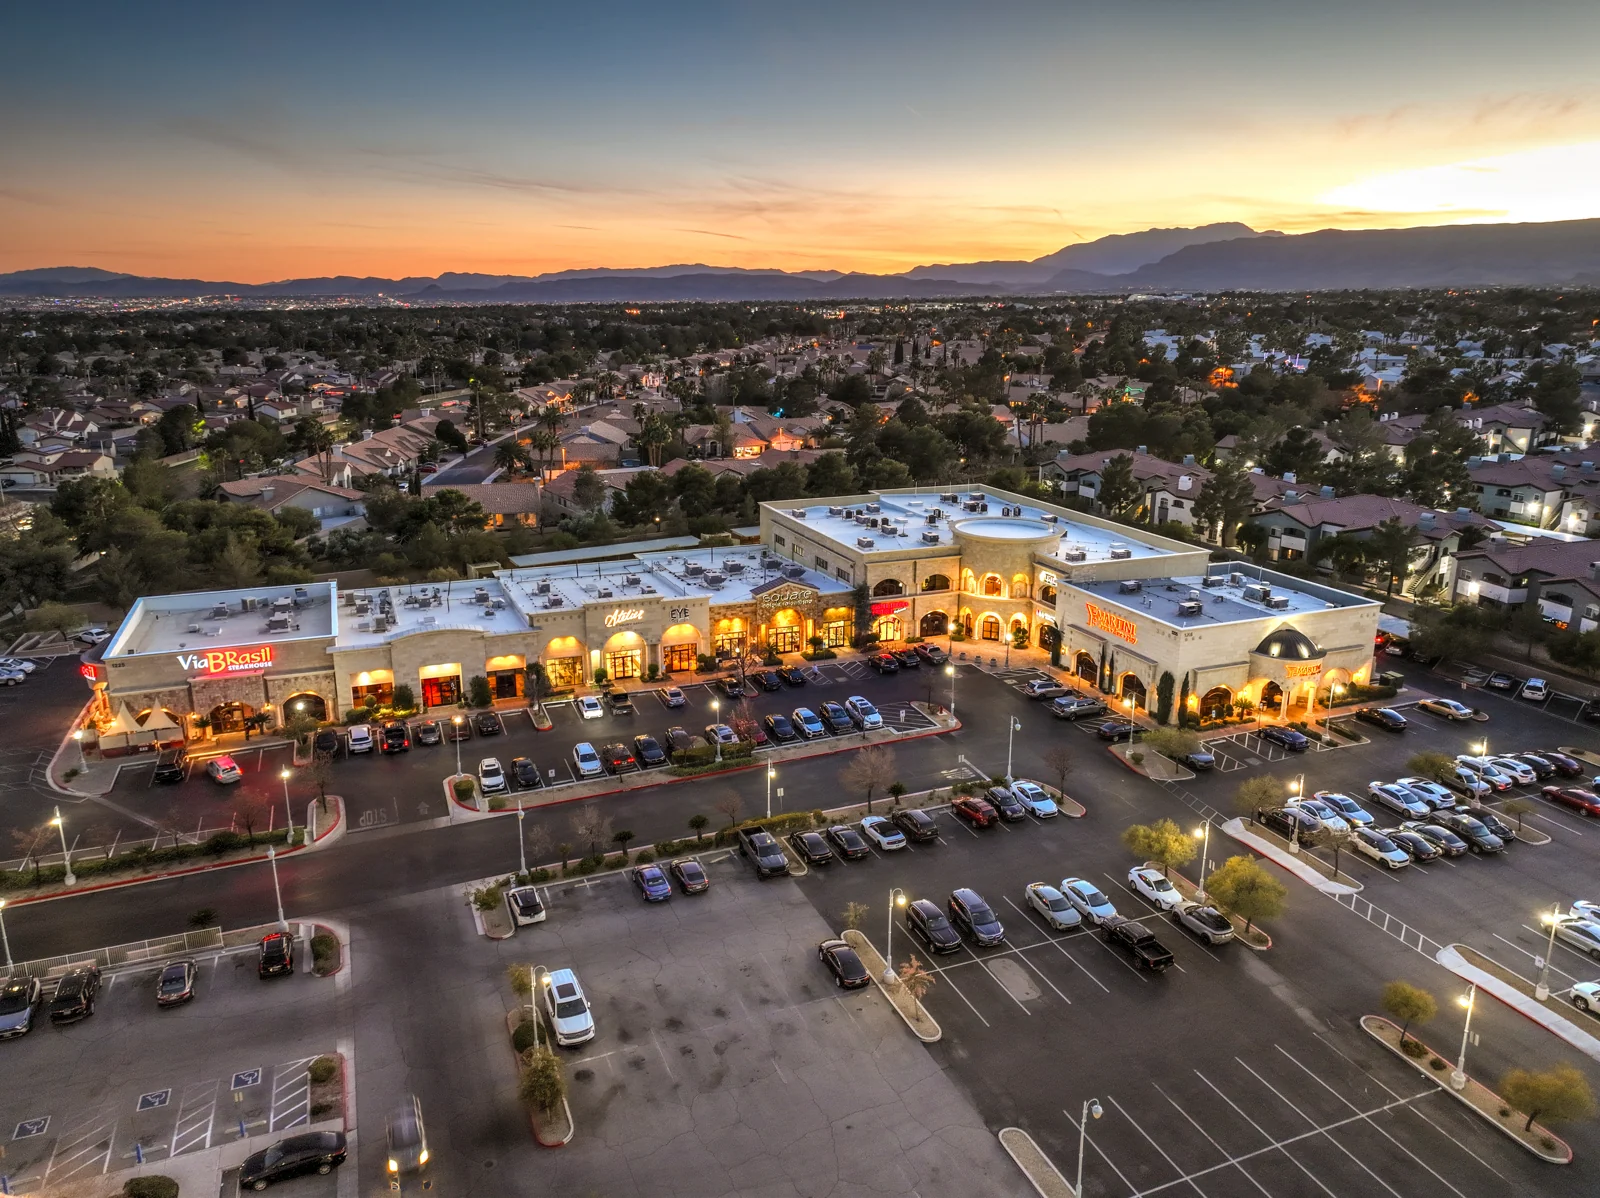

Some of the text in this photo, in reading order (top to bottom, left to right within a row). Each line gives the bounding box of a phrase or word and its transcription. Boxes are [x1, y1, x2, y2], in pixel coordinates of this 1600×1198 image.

[604, 608, 645, 628] Atelier
[670, 607, 690, 619] EYE
[1098, 608, 1137, 636] MARTINI
[227, 661, 272, 672] STEAKHOUSE
[359, 808, 387, 827] STOP
